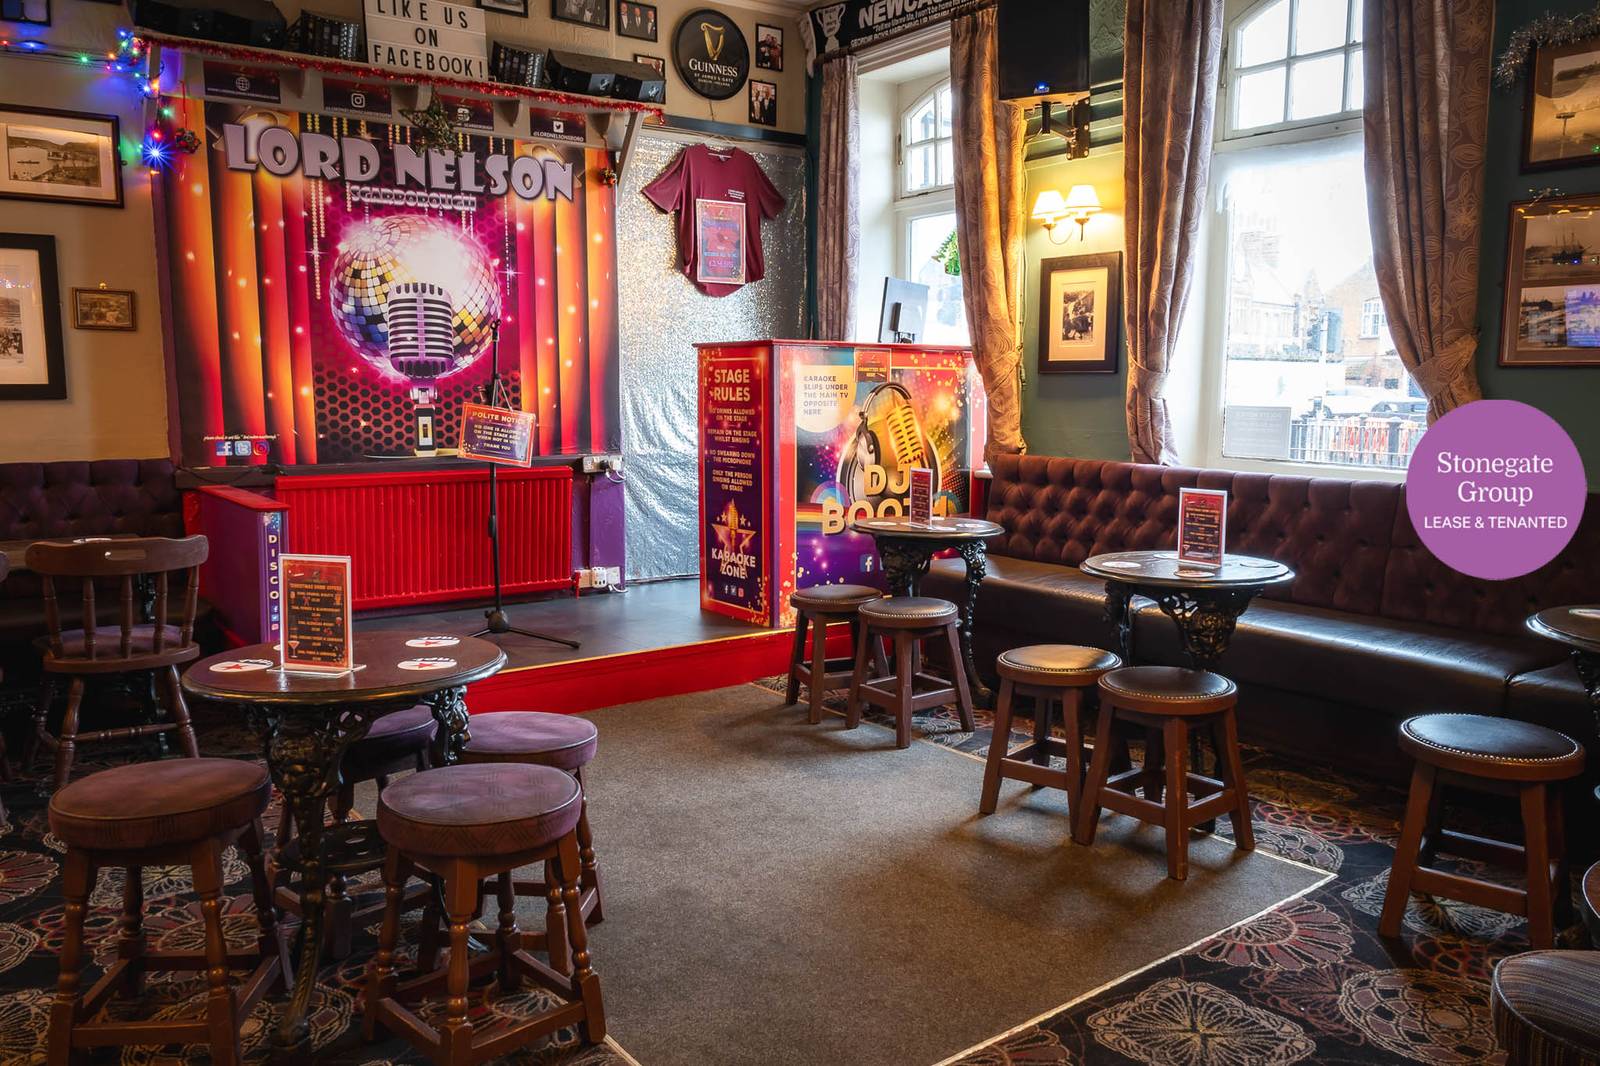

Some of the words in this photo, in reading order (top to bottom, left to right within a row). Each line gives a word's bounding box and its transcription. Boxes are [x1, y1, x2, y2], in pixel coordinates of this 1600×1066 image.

[377, 0, 428, 21] LIKE
[444, 7, 468, 29] US
[415, 27, 438, 47] ON
[373, 44, 483, 79] FACEBOOK!
[688, 58, 738, 78] GUINNESS
[222, 123, 381, 182] LORD
[393, 143, 573, 202] NELSON
[350, 185, 477, 211] SCARBOROUGH
[714, 368, 750, 383] STAGE
[713, 387, 751, 402] RULES
[472, 411, 499, 421] POLITE
[733, 408, 755, 416] ALLOWED
[743, 430, 757, 438] STAGE
[717, 450, 740, 458] SWEARING
[741, 451, 755, 459] DOWN
[731, 478, 753, 486] ALLOWED
[734, 472, 753, 480] PERSON
[863, 464, 911, 496] DJ
[711, 547, 757, 568] KARAOKE
[268, 534, 279, 600] DISCO
[721, 563, 746, 580] ZONE
